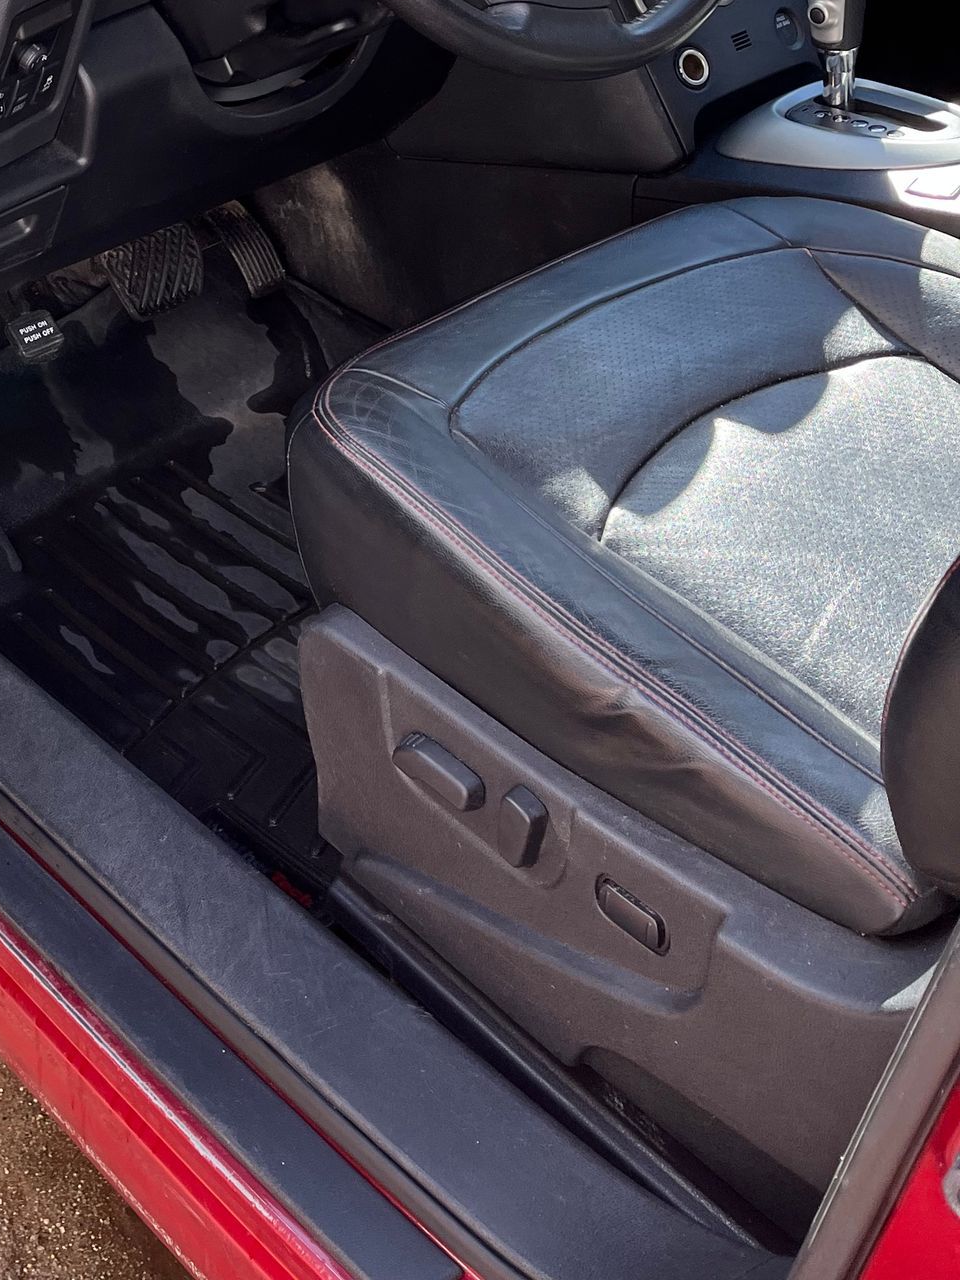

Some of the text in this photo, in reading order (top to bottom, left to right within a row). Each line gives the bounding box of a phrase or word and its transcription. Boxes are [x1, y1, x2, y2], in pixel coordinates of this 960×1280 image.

[19, 320, 48, 335] PUSH ON
[24, 327, 54, 344] PUSH OFF
